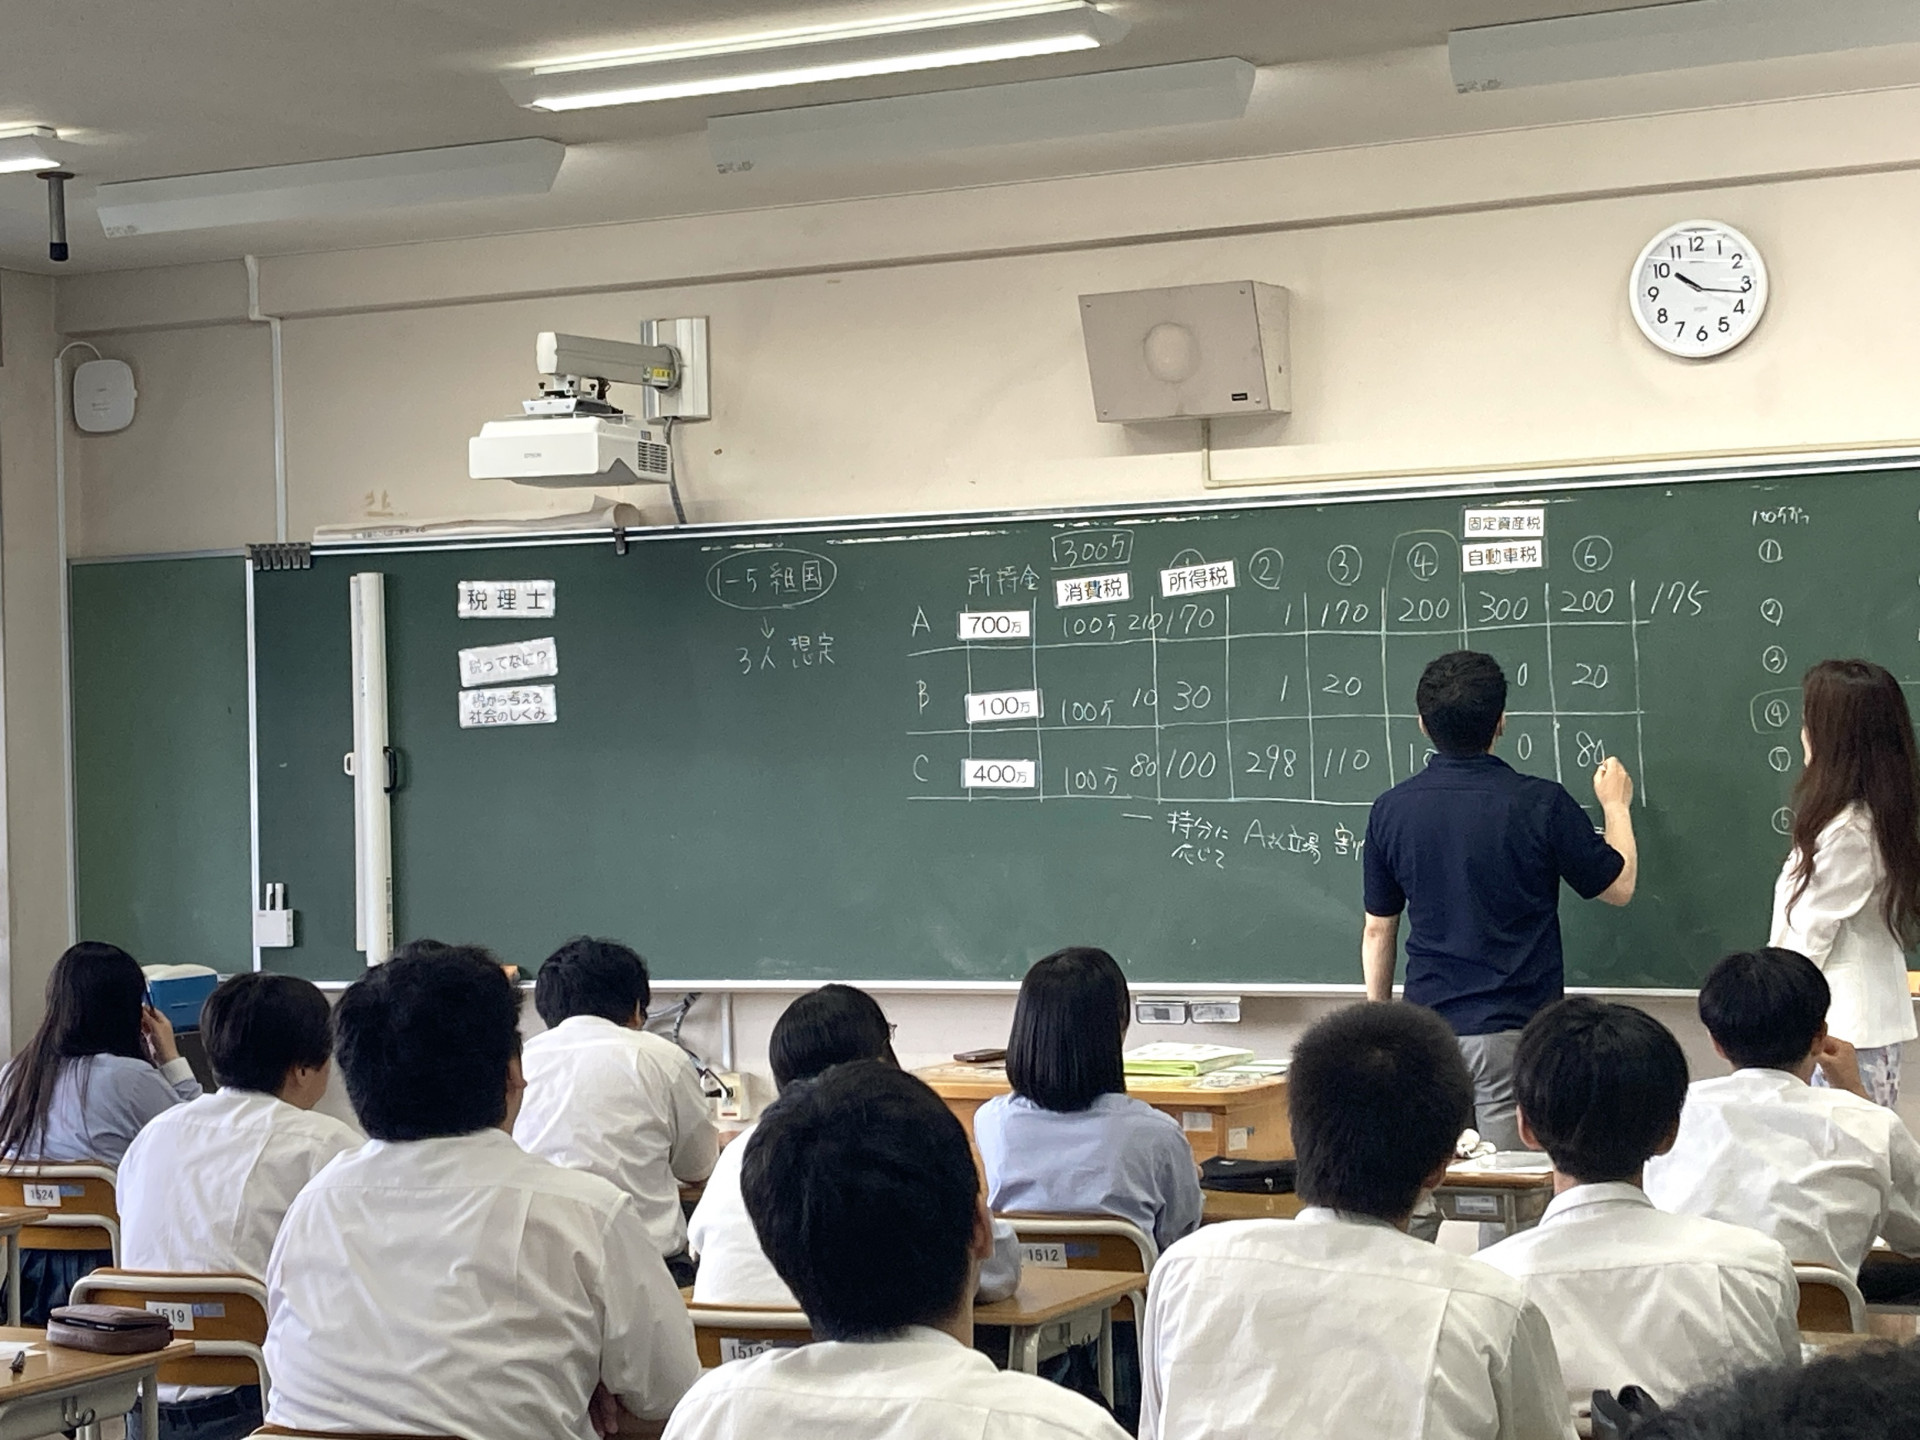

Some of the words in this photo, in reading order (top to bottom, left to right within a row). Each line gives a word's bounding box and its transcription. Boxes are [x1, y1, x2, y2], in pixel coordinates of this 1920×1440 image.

[1689, 236, 1704, 252] 12
[1717, 240, 1722, 255] 1
[1670, 245, 1681, 261] 11
[1732, 253, 1743, 269] 2
[1653, 263, 1670, 279] 10
[1740, 276, 1752, 293] 3
[1648, 286, 1659, 302] 9
[1733, 299, 1745, 314] 4
[1657, 308, 1668, 324] 8
[1717, 316, 1730, 333] 5
[1675, 321, 1685, 338] 7
[1696, 325, 1708, 342] 6
[1468, 516, 1540, 531] 固定資産税
[1468, 546, 1537, 566] 自動車税
[1168, 566, 1229, 593] 所得税
[1064, 577, 1123, 603] 消費税
[468, 589, 546, 611] 税理士
[1478, 592, 1529, 622] 300
[1561, 588, 1614, 614] 200
[1399, 597, 1449, 622] 200
[911, 606, 931, 637] A
[968, 616, 1021, 634] 700万
[1572, 663, 1609, 689] 20
[1322, 676, 1362, 696] 20
[1173, 681, 1212, 711] 30
[978, 697, 1031, 716] 100万
[469, 707, 547, 724] 社会のしくみ
[913, 755, 929, 782] C
[1247, 745, 1297, 781] 298
[972, 765, 1028, 783] 400万
[30, 1188, 54, 1202] 1524
[1028, 1248, 1059, 1262] 1512
